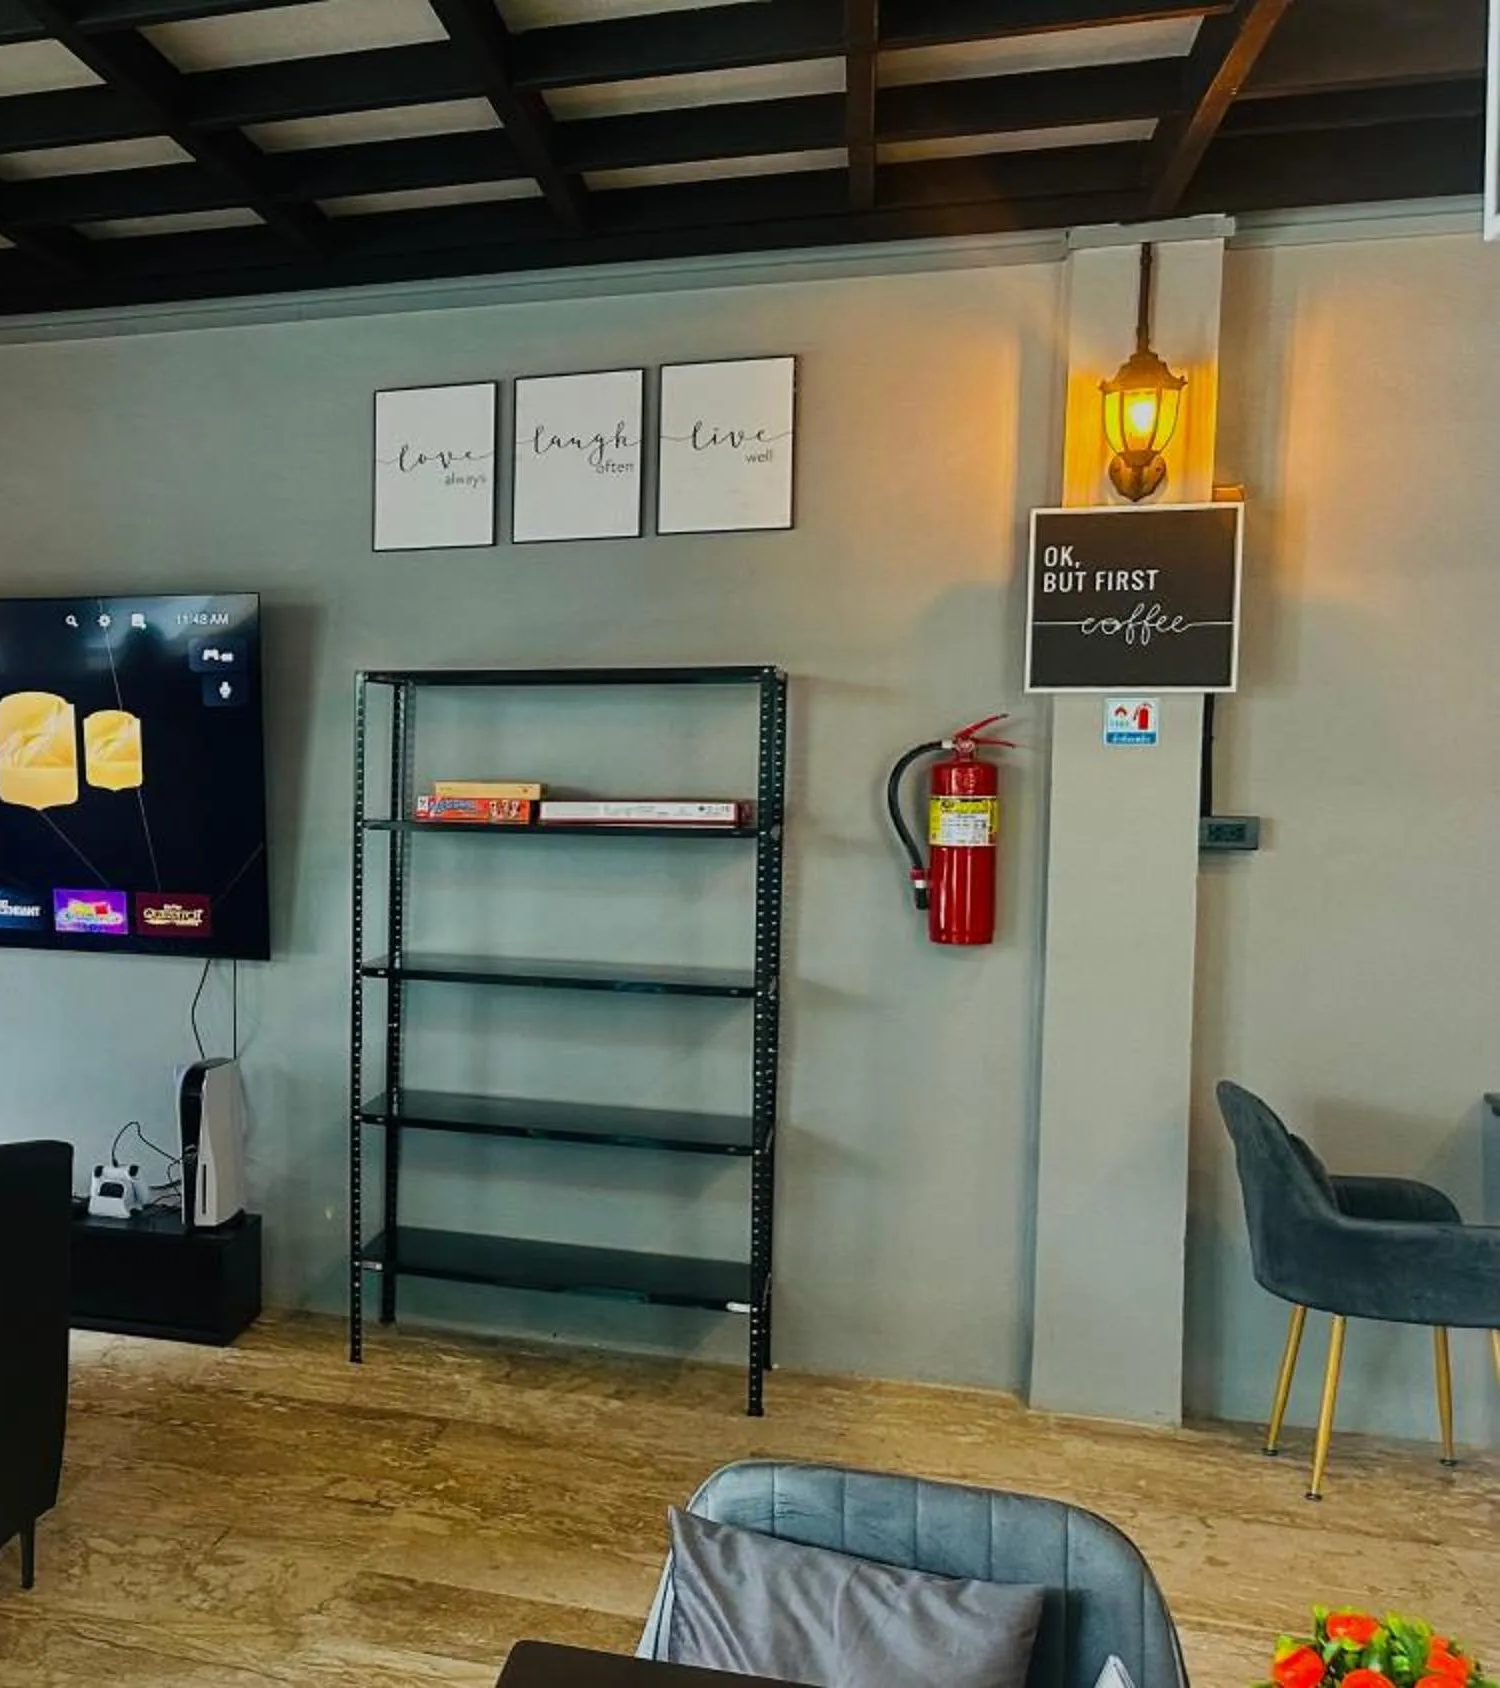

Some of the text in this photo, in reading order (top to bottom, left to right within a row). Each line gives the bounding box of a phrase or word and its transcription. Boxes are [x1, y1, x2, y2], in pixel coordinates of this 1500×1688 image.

[532, 421, 638, 465] laugh
[690, 421, 772, 451] live
[394, 444, 480, 472] love
[595, 461, 635, 474] often
[746, 451, 774, 465] well
[444, 473, 487, 488] always
[1043, 546, 1081, 568] OK,
[1042, 569, 1160, 594] BUT FIRST
[1080, 602, 1192, 646] coffee
